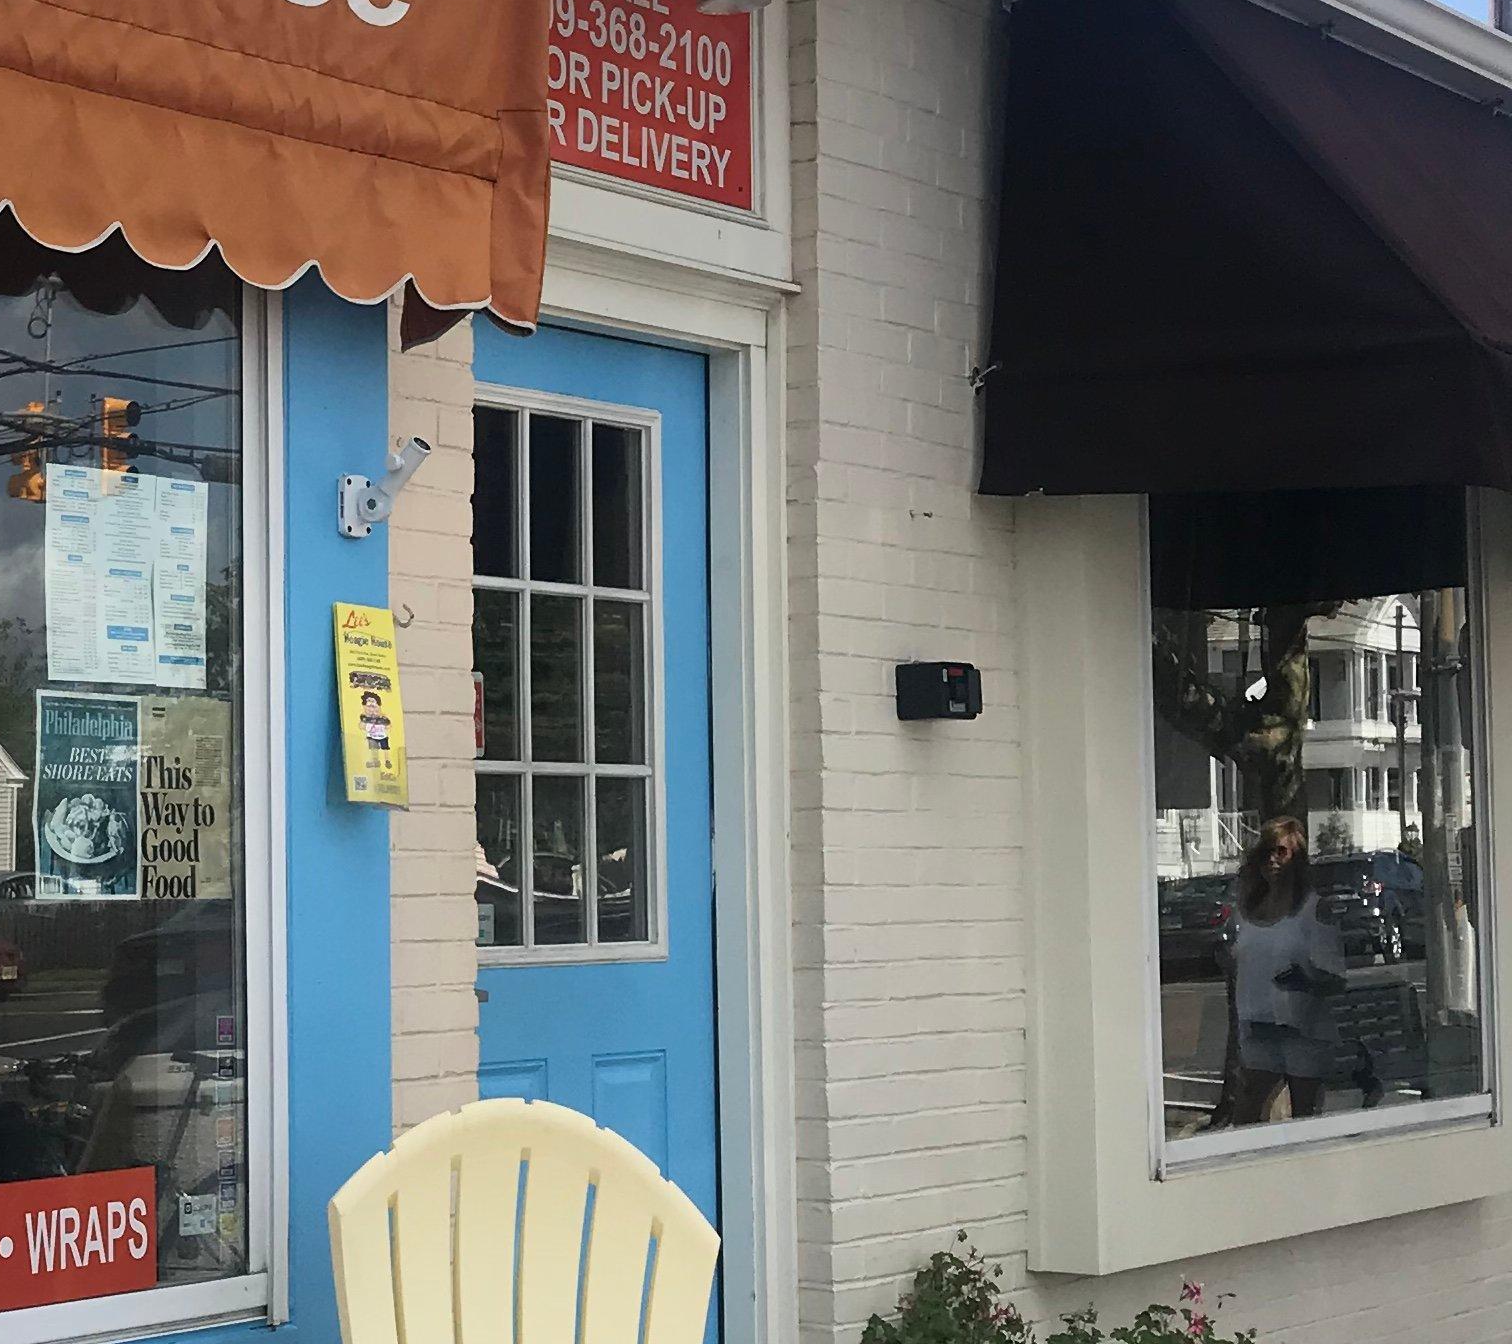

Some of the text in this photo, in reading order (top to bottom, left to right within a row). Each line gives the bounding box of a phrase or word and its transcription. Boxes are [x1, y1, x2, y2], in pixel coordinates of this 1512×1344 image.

[601, 61, 727, 134] PICK-UP
[577, 108, 731, 188] DELIVERY
[45, 709, 134, 741] Philadelphia
[43, 763, 134, 782] SHORE EATS
[69, 747, 107, 763] BEST
[141, 755, 193, 790] This
[140, 791, 215, 834] Way to
[141, 827, 200, 863] Good
[141, 864, 196, 898] Food
[25, 1197, 148, 1275] WRAPS
